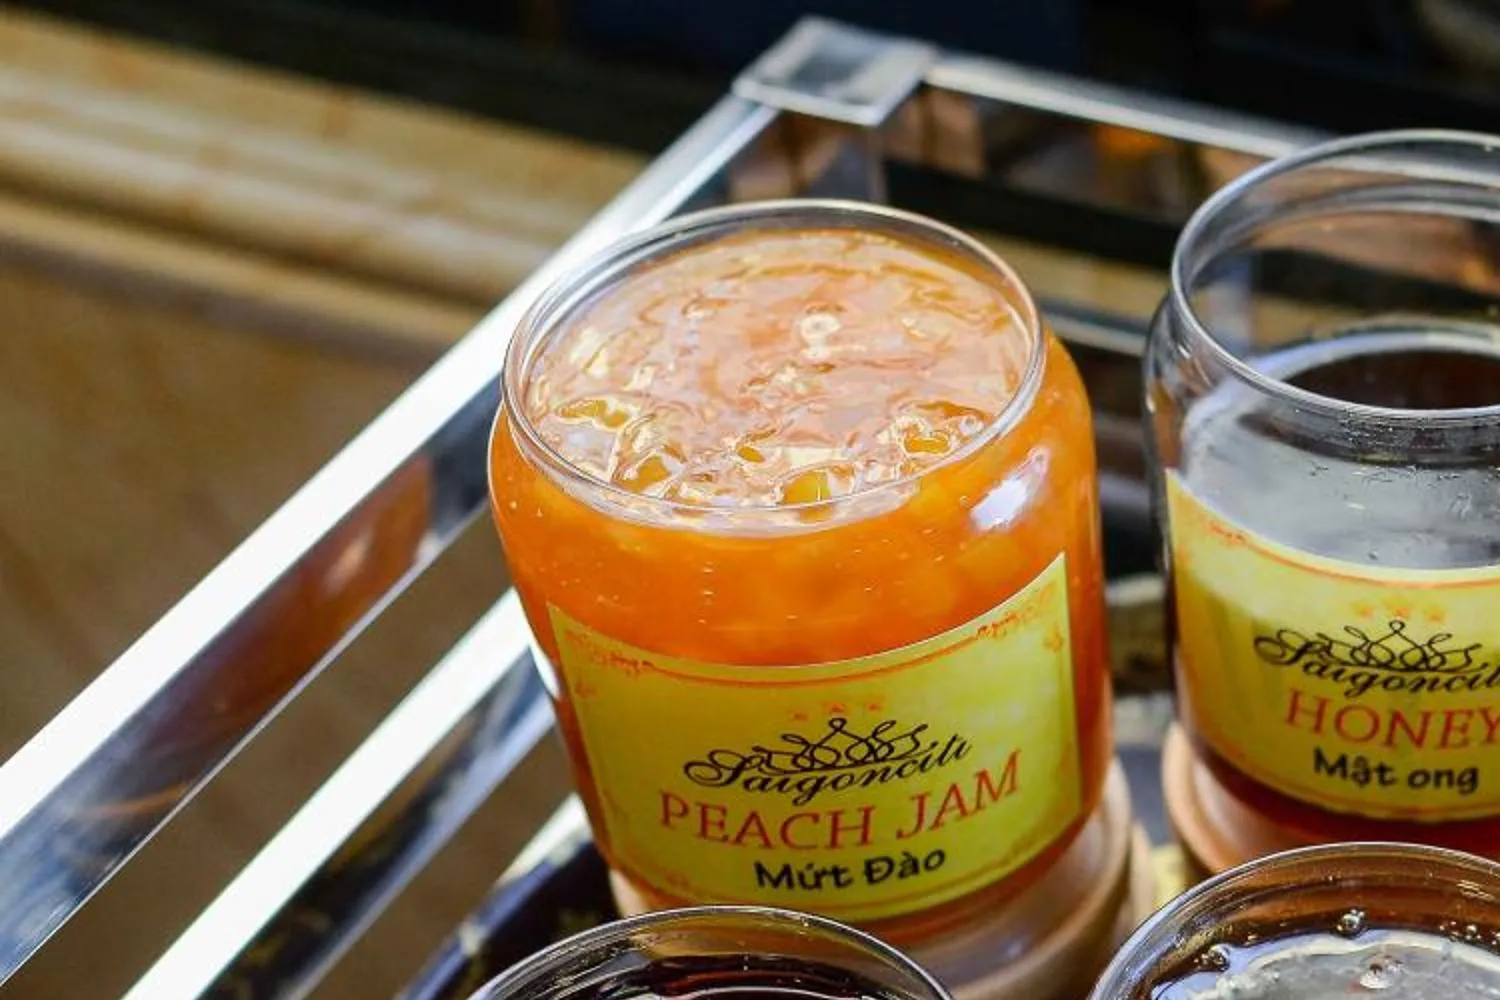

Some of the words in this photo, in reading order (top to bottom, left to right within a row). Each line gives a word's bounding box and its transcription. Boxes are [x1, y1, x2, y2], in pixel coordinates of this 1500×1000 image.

[1313, 748, 1398, 786] Mật
[1407, 764, 1480, 795] ong
[659, 789, 878, 851] PEACH
[895, 749, 1023, 841] JAM
[753, 859, 852, 892] Mứt
[864, 846, 948, 886] Đào
